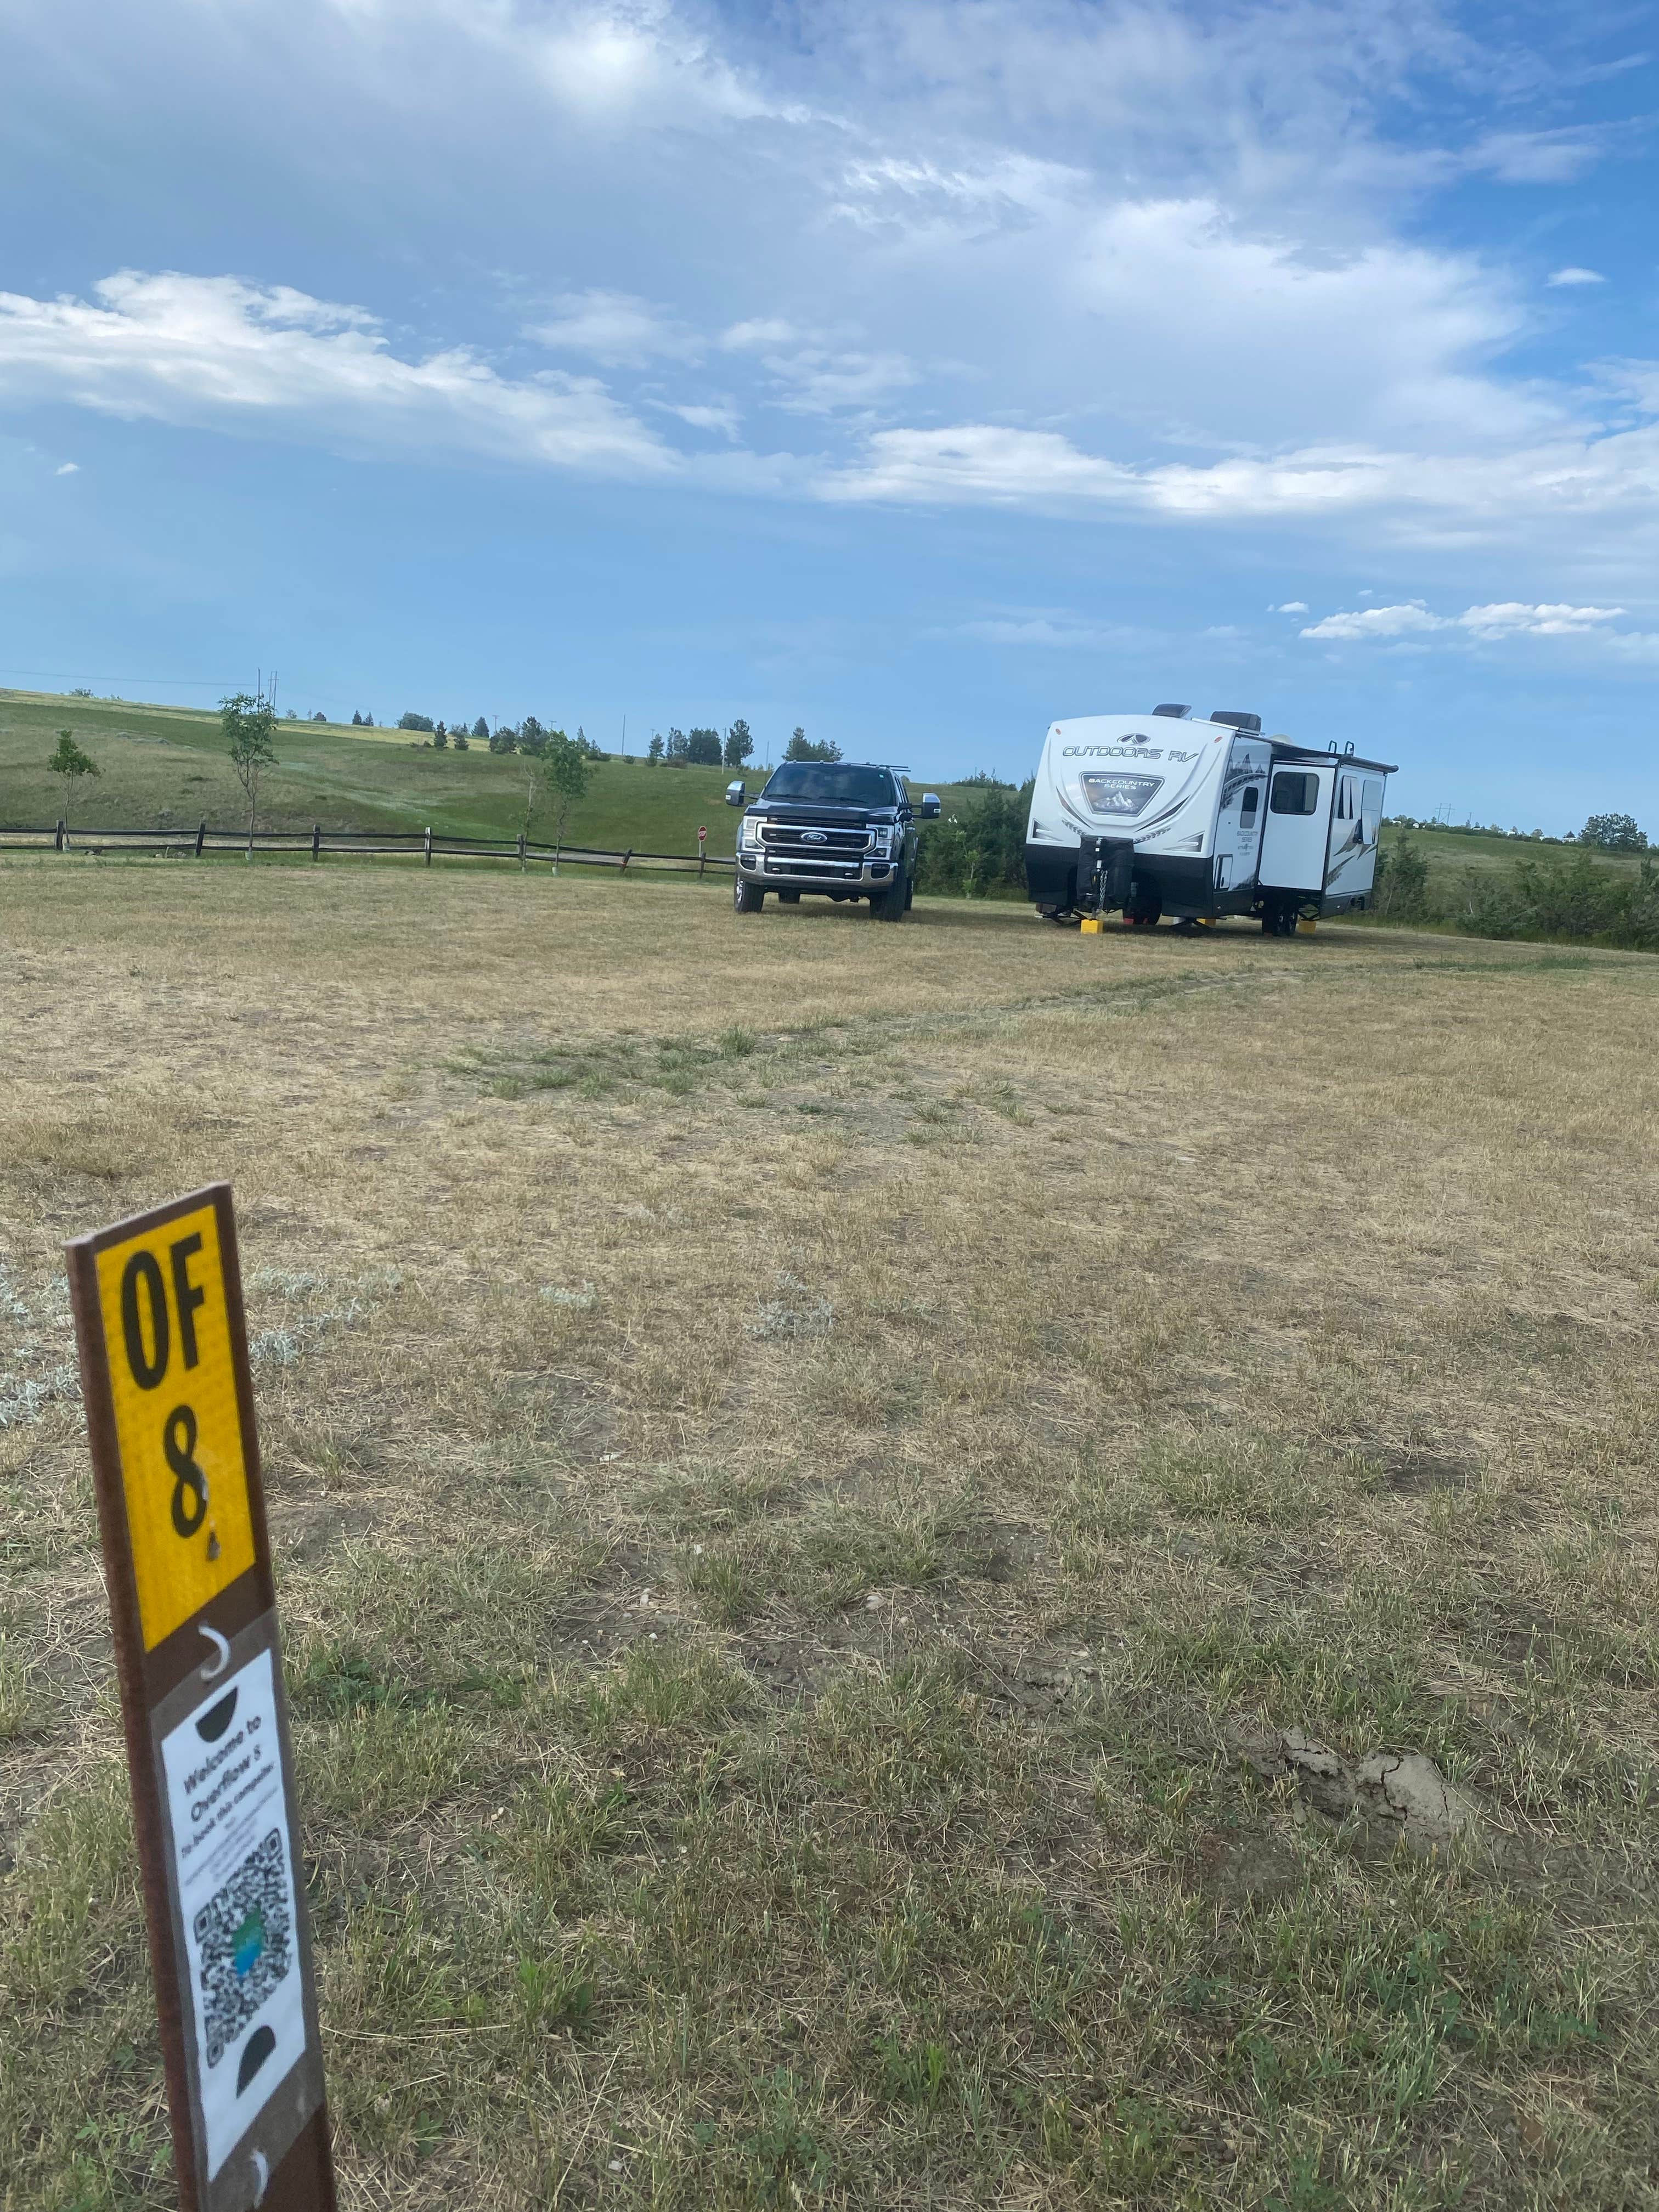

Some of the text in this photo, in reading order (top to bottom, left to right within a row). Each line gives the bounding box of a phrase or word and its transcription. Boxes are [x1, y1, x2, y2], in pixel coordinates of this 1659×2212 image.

[1062, 746, 1200, 763] OUTDOORS RV
[1088, 778, 1155, 787] BACKCOUNTRY
[164, 1404, 207, 1538] 8
[183, 1716, 261, 1795] Welcome to
[191, 1755, 250, 1822] Overflow
